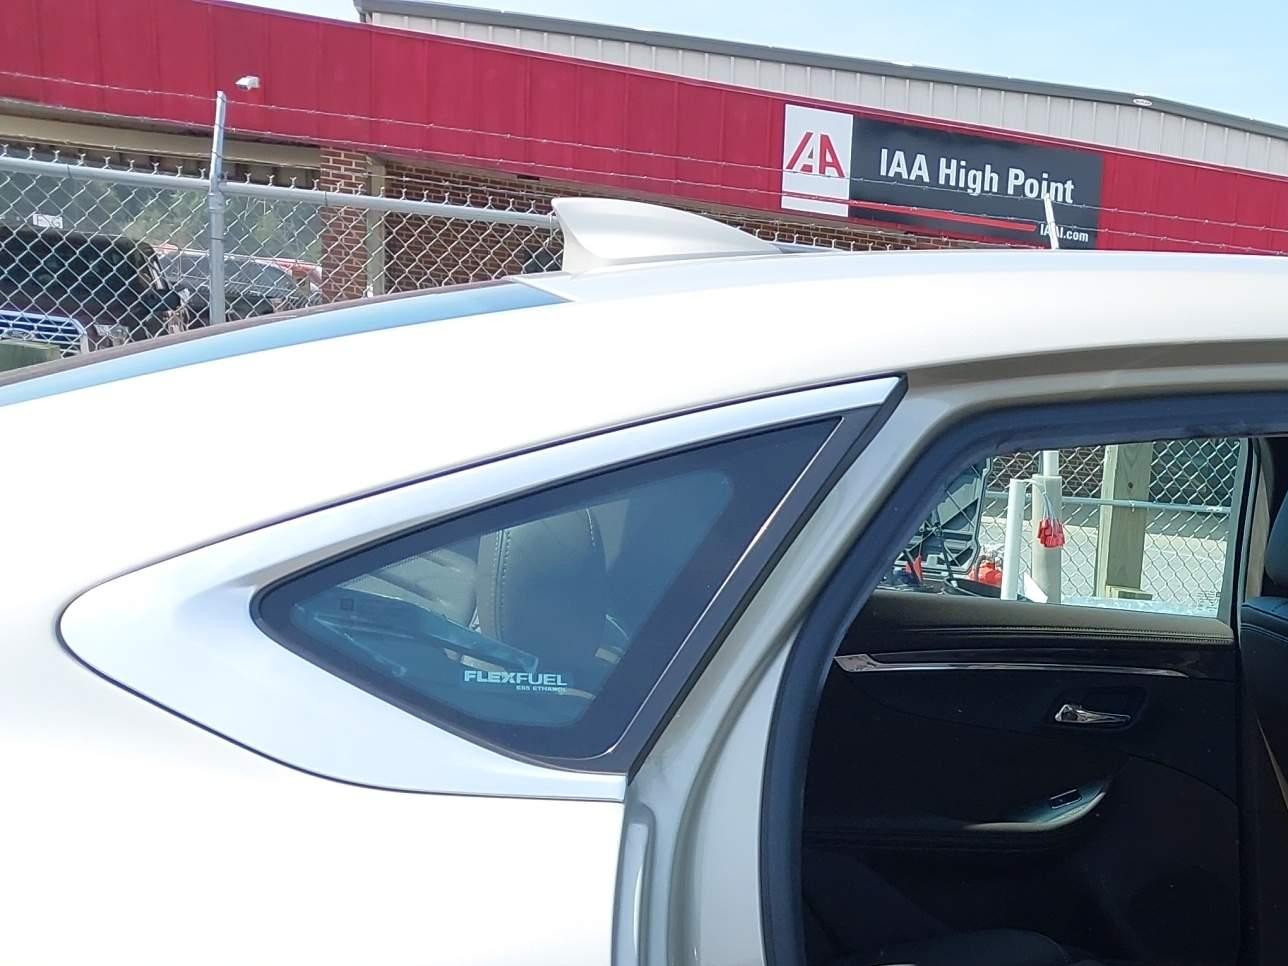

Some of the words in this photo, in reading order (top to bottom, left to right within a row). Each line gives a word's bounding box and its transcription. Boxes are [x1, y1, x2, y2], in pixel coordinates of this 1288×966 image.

[879, 148, 930, 183] IAA
[938, 157, 999, 196] High
[1007, 167, 1075, 204] Point
[464, 670, 568, 686] FLEXFUEL
